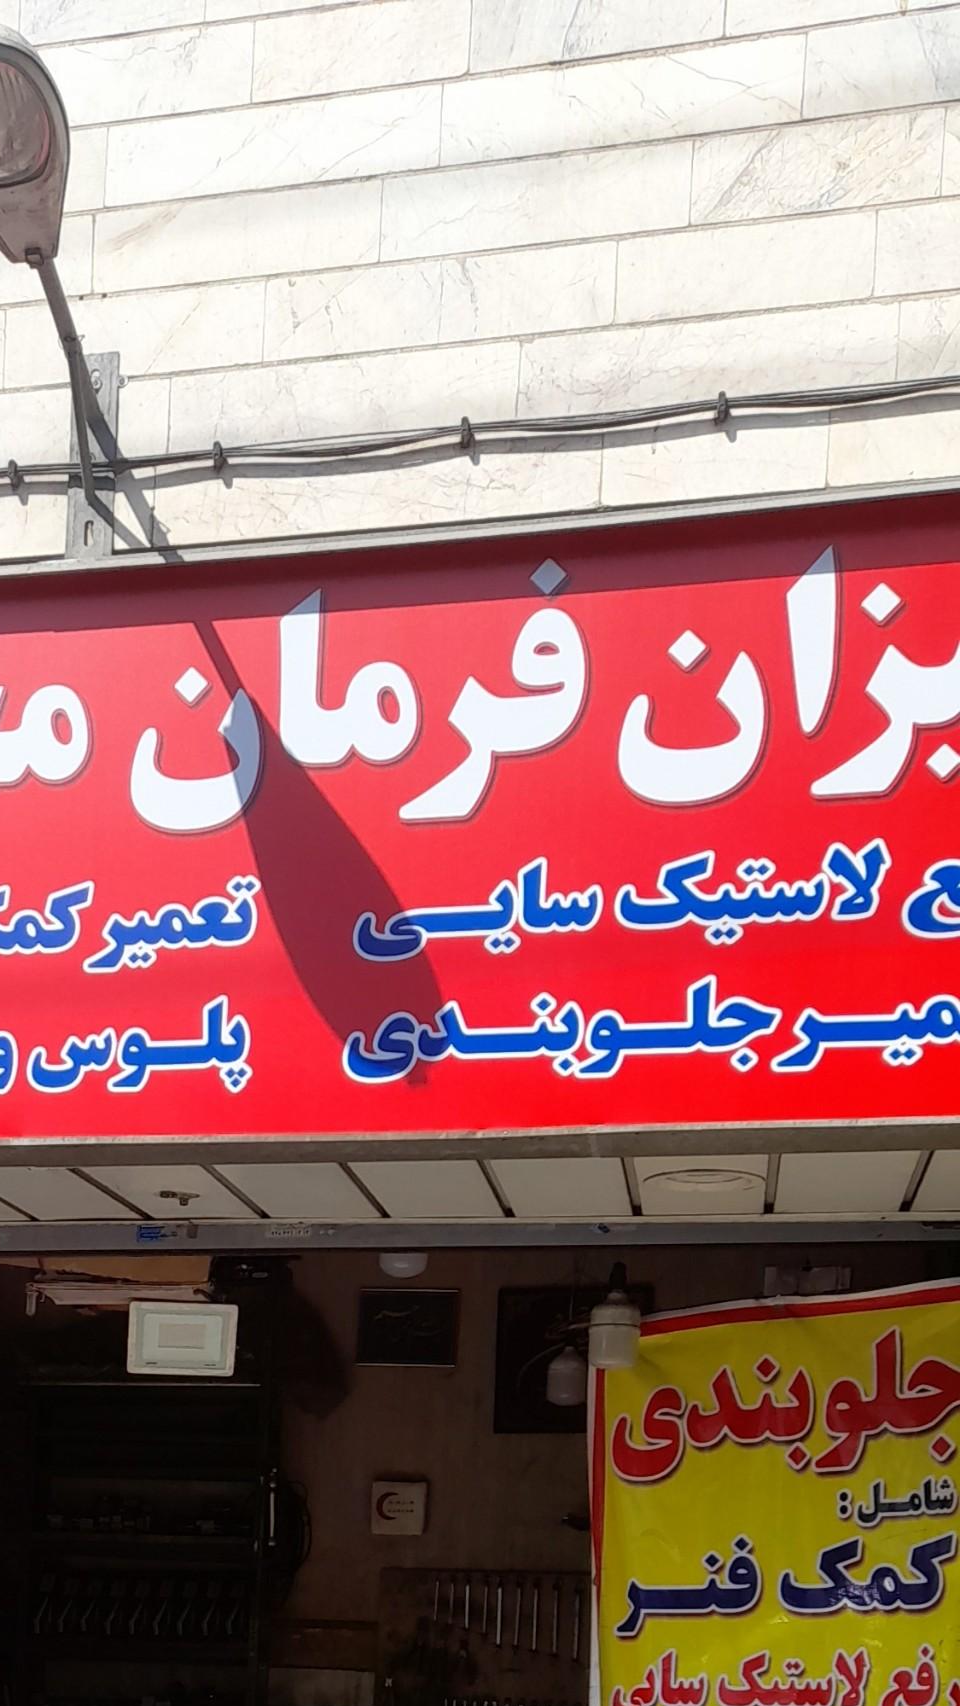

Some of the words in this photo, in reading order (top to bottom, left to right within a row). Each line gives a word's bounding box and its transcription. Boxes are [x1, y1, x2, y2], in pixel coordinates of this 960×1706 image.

[130, 557, 590, 833] فرمان
[618, 543, 960, 806] یزان
[83, 875, 261, 974] تعمیر
[353, 856, 604, 962] سایی
[614, 837, 891, 941] لاستیک
[27, 995, 252, 1093] پلوس
[342, 976, 782, 1083] جلوبندی
[771, 995, 960, 1072] میر
[611, 1326, 960, 1480] جلوبندی
[615, 1534, 762, 1637] فنر
[780, 1531, 958, 1614] کمک
